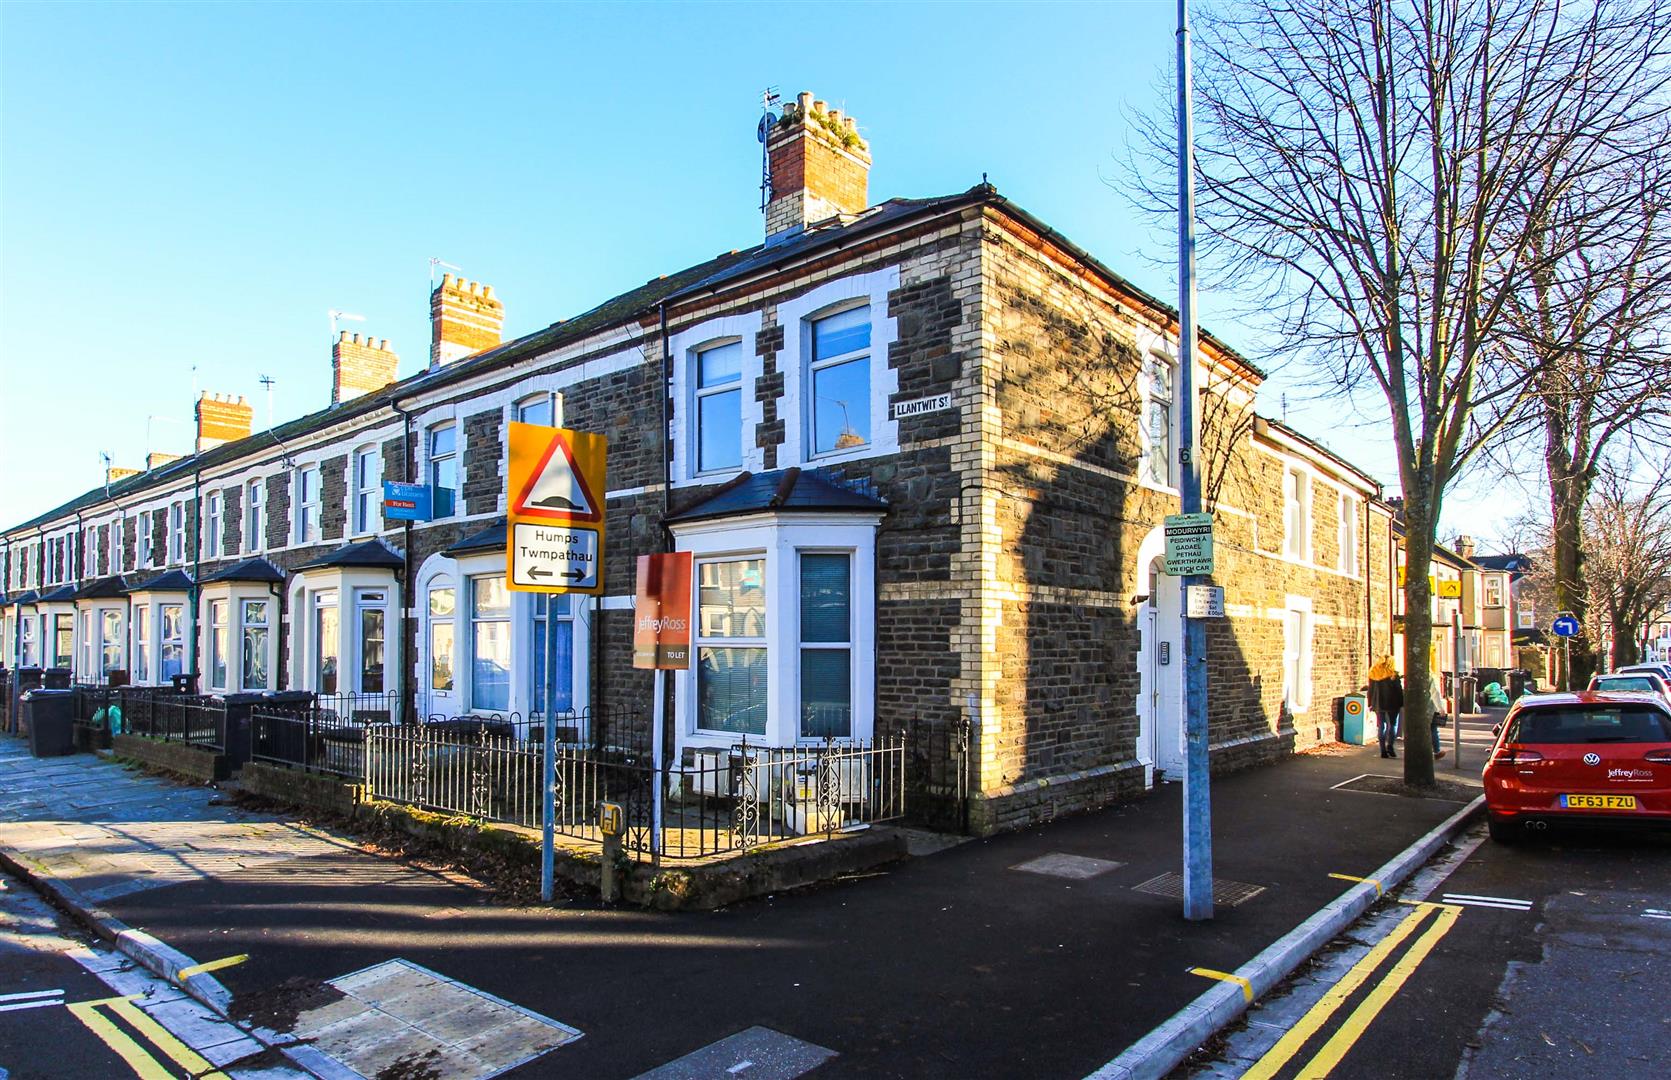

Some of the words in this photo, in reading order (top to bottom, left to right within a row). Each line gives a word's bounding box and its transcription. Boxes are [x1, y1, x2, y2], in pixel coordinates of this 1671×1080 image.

[897, 399, 937, 415] LLANTWIT
[1181, 448, 1189, 462] 6
[536, 530, 578, 544] Humps
[520, 546, 593, 562] Twmpathau
[667, 651, 675, 659] TO
[675, 651, 685, 659] LET
[1569, 796, 1604, 807] CF63
[1607, 797, 1634, 808] FZU
